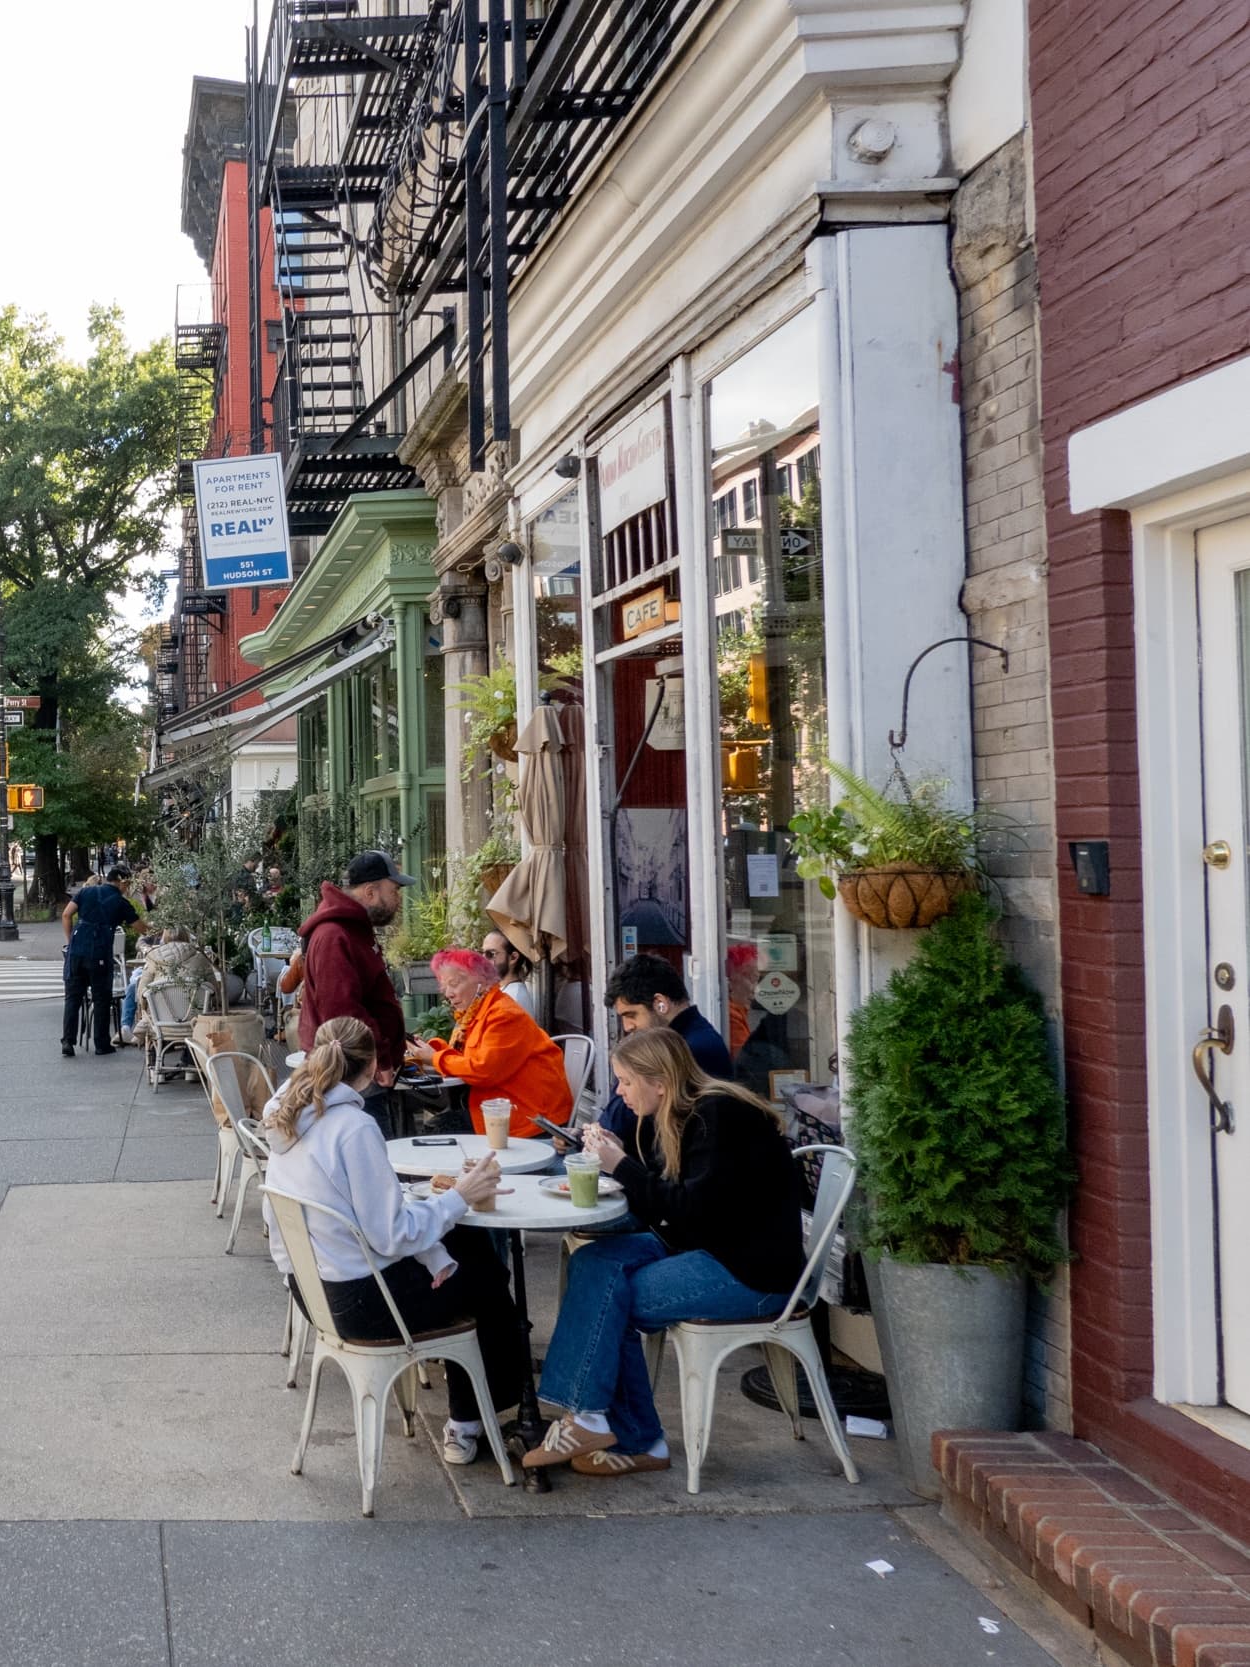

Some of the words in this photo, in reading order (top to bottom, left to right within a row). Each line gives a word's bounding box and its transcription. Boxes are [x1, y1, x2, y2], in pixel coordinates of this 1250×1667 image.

[206, 472, 271, 484] APARTMENTS
[215, 485, 235, 493] FOR
[238, 482, 263, 490] RENT
[207, 501, 228, 510] (212)
[230, 496, 275, 507] REAL-NYC
[239, 560, 254, 569] 551
[222, 570, 260, 580] HUDSON
[261, 568, 273, 576] ST
[626, 599, 659, 629] CAFE
[6, 698, 20, 707] Perry
[21, 698, 27, 706] St
